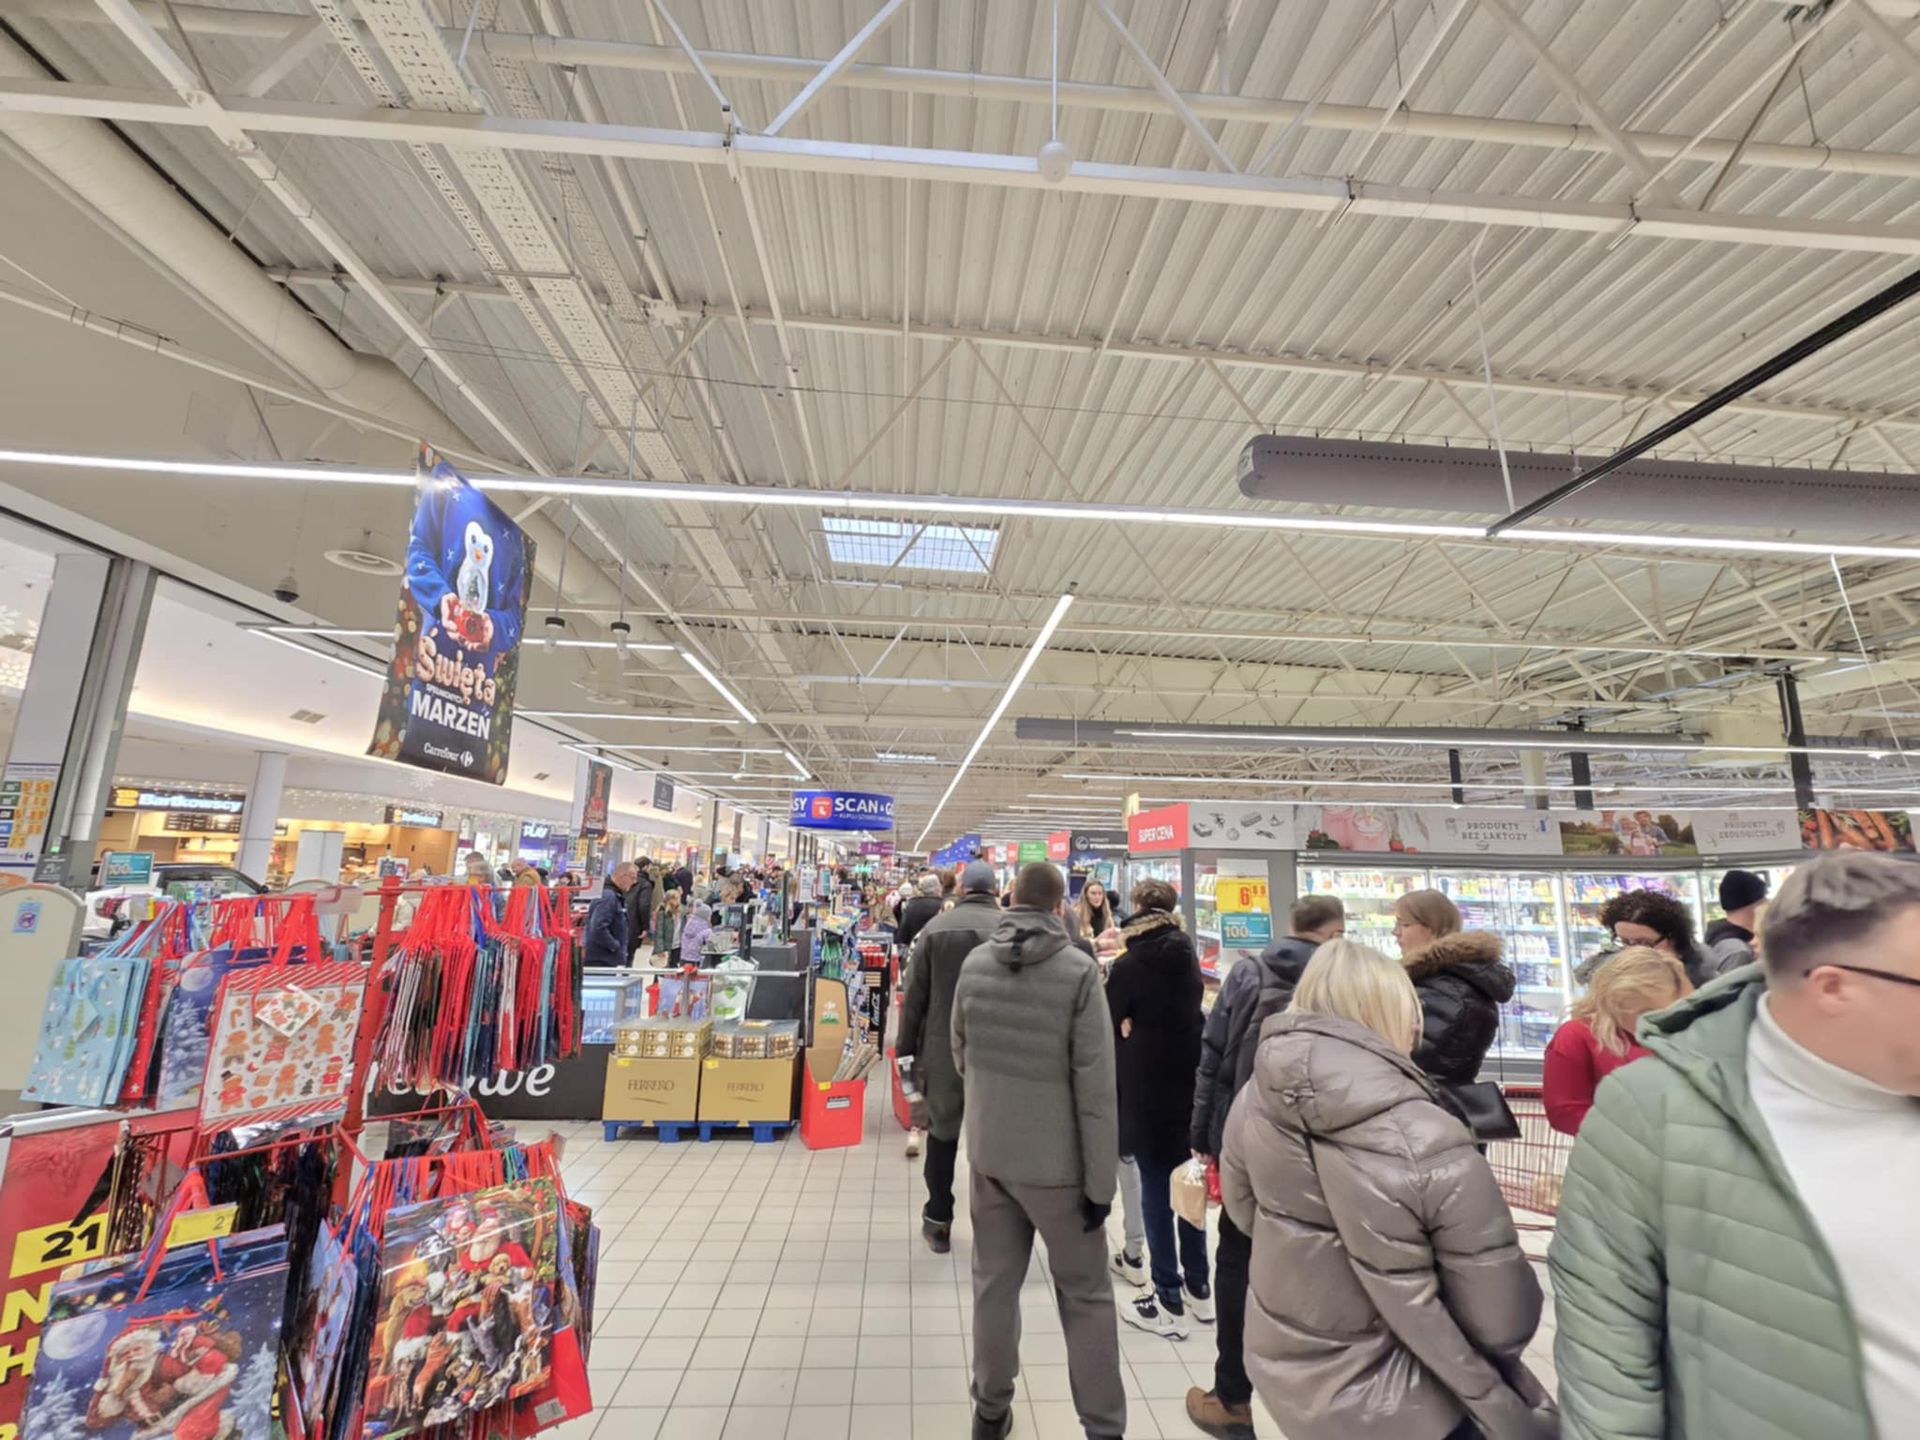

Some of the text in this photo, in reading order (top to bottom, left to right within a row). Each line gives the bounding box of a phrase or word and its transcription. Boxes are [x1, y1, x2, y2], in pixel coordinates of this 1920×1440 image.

[416, 627, 497, 706] Święta
[411, 690, 491, 740] MARZEŃ
[424, 742, 460, 761] Carrefour
[835, 797, 878, 814] SCAN
[1467, 822, 1520, 831] PRODUKTY
[1462, 832, 1528, 841] BEZ LAKTOZY
[1240, 886, 1250, 906] 6
[1224, 926, 1249, 938] 100
[627, 1079, 675, 1092] FERRERO
[726, 1082, 765, 1092] FERRERO
